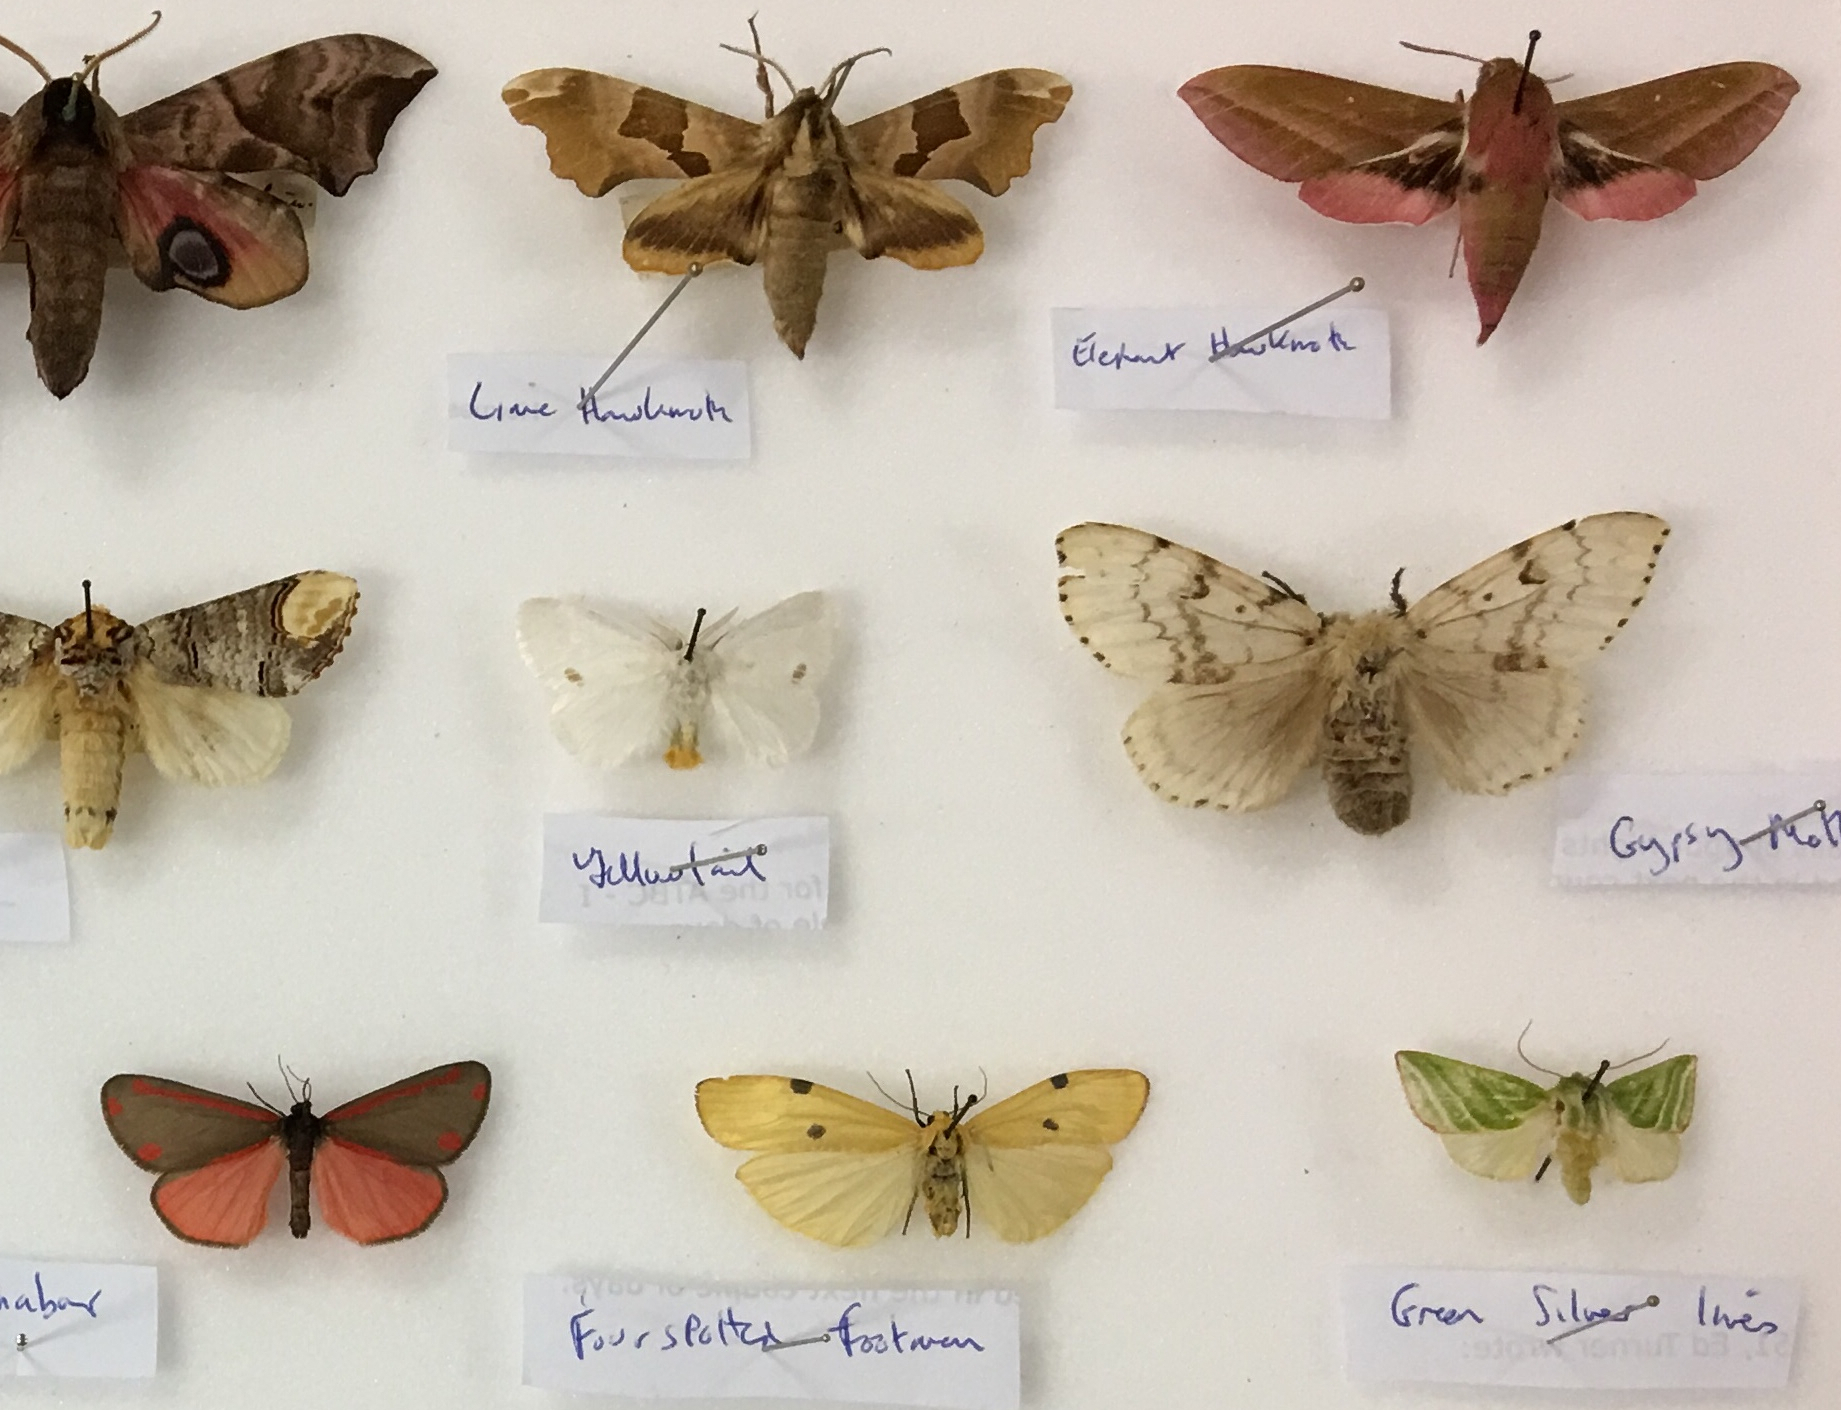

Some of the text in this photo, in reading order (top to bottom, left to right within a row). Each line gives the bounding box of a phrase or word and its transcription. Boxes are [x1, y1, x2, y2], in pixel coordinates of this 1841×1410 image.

[469, 381, 556, 422] Lime
[1608, 816, 1743, 877] Gypsy
[1390, 1282, 1485, 1327] Green
[1532, 1283, 1640, 1327] Silver
